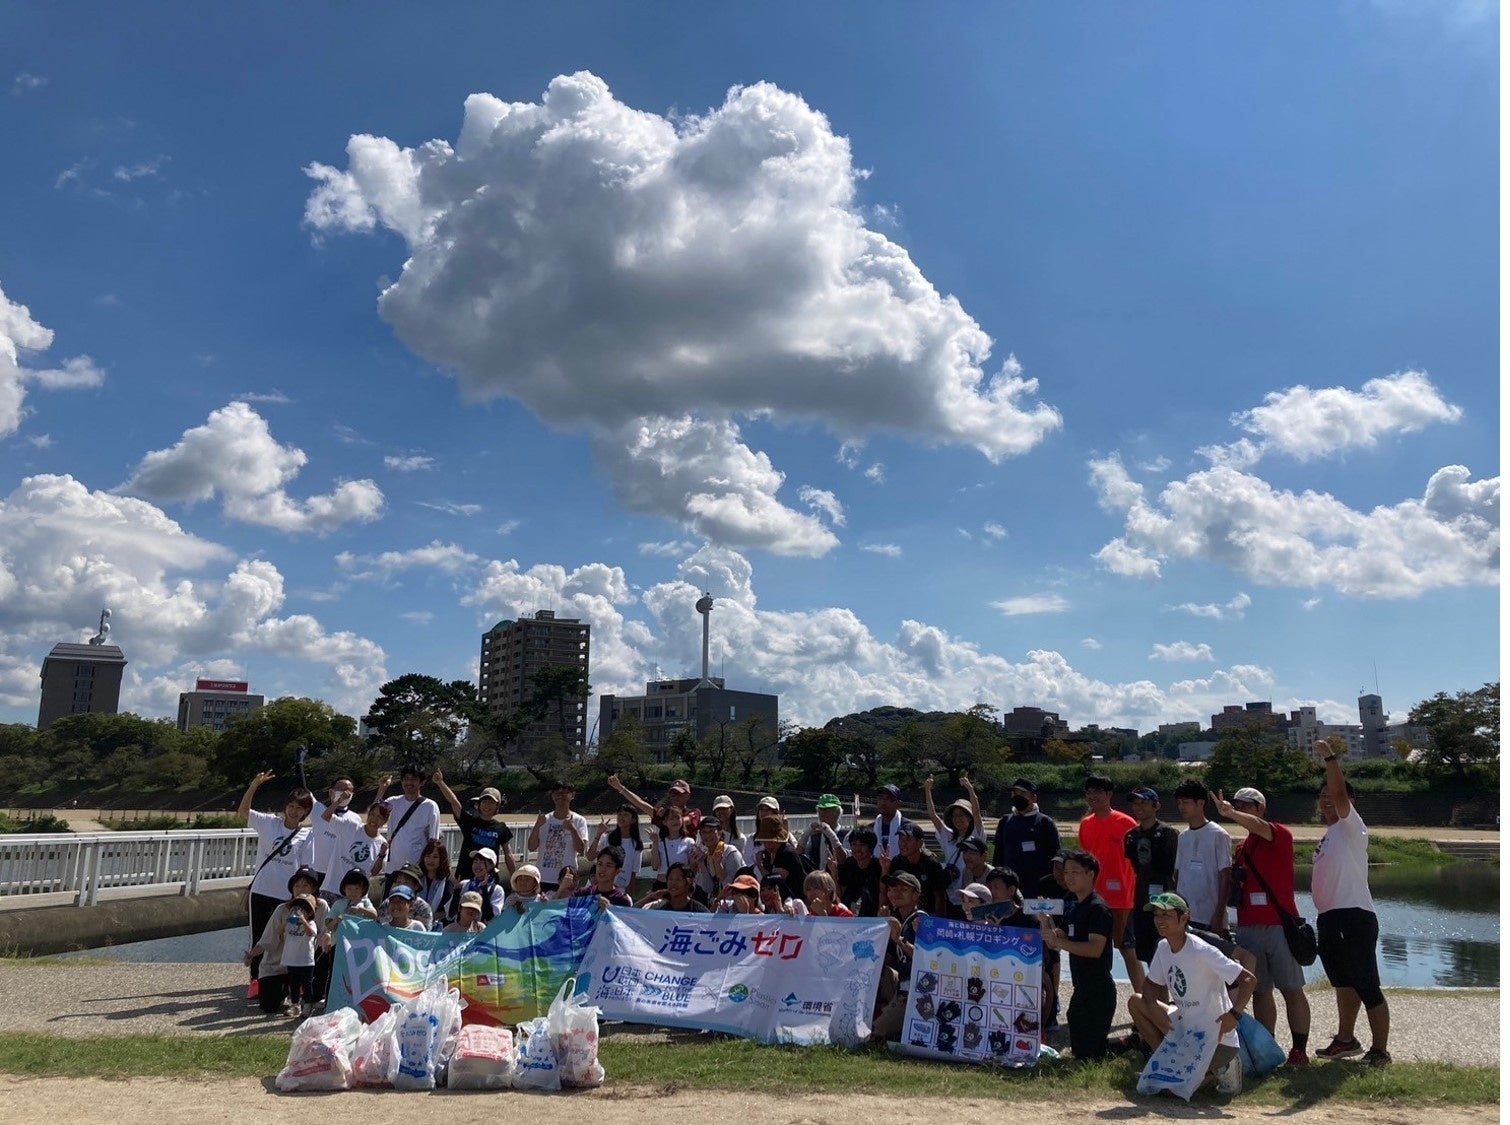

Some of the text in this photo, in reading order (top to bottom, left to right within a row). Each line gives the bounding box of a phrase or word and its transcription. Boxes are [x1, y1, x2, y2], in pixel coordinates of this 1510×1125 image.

[658, 926, 803, 960] 海ごみゼロ
[644, 971, 698, 987] CHANGE
[662, 992, 691, 1002] BLUE
[802, 1001, 834, 1012] 環境省
